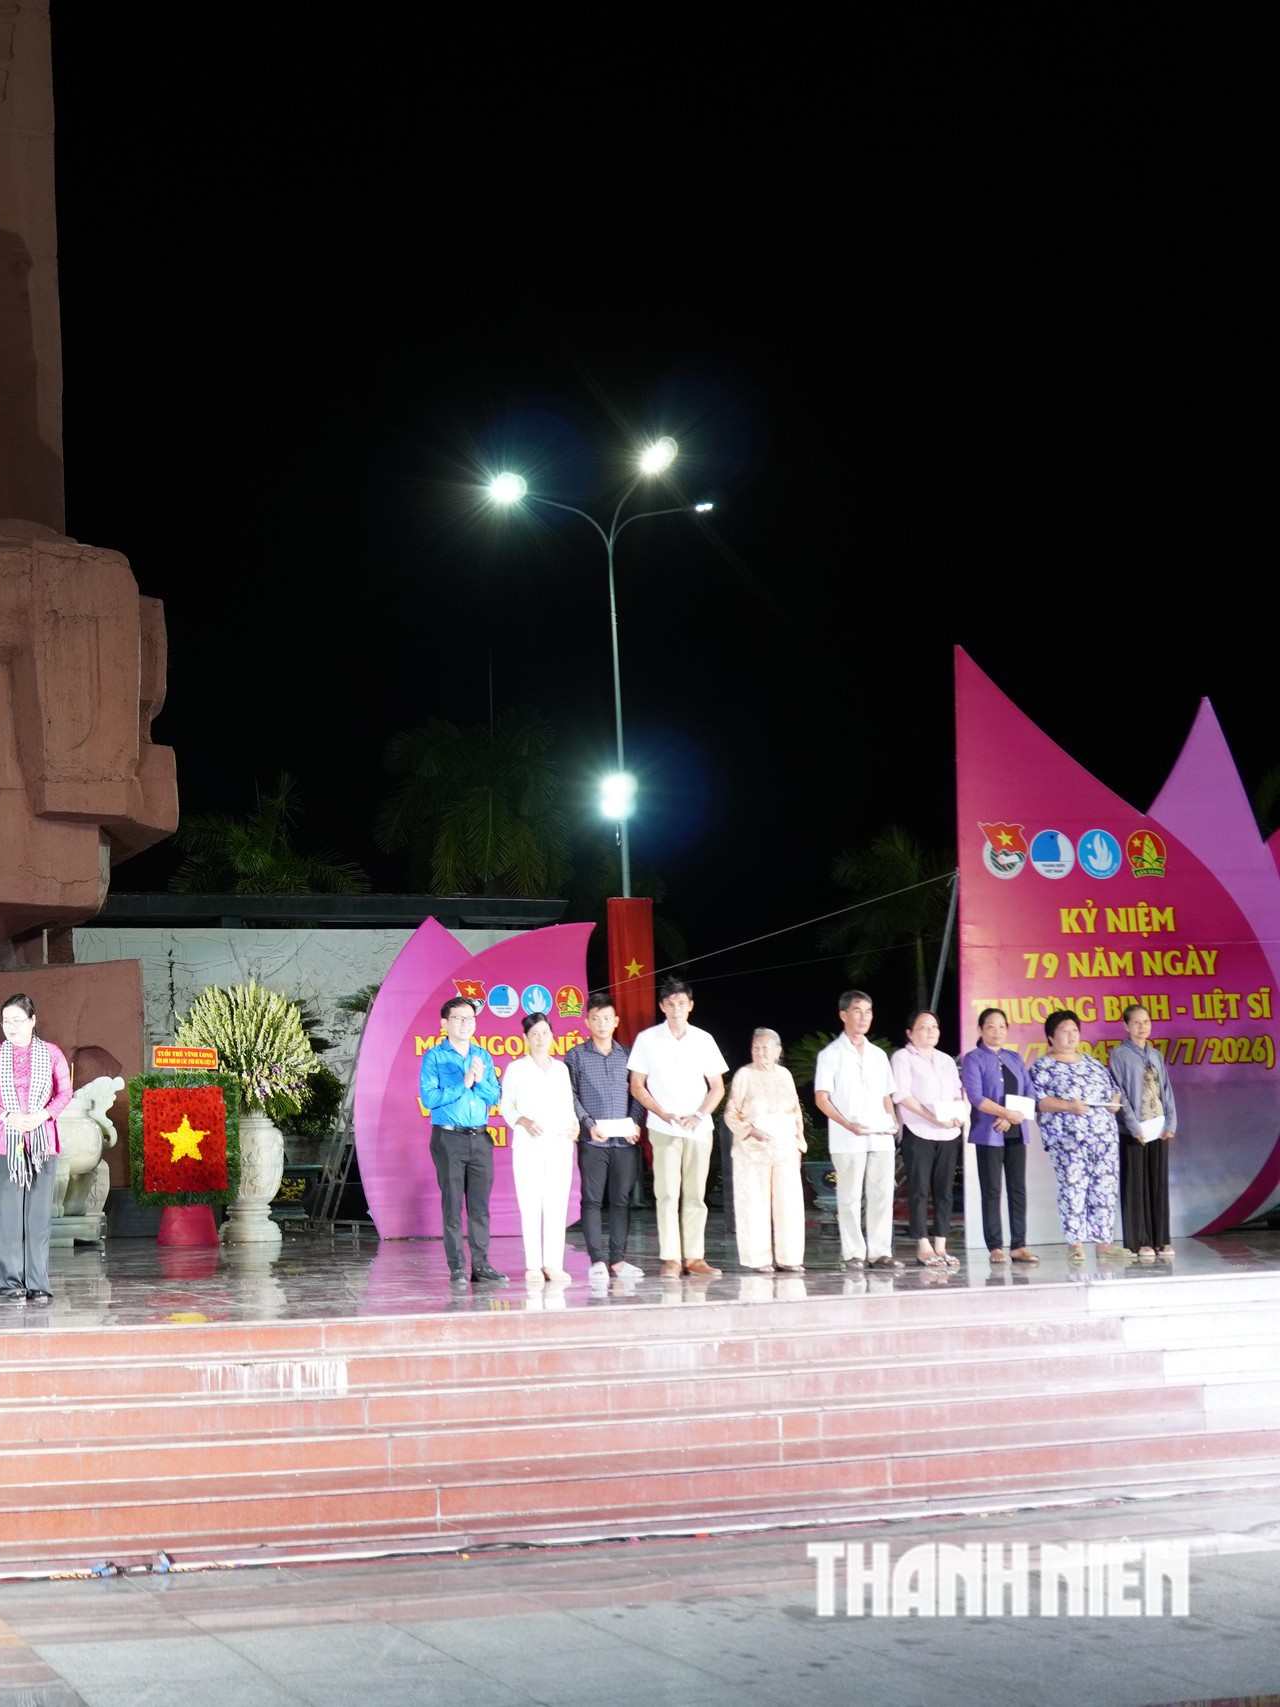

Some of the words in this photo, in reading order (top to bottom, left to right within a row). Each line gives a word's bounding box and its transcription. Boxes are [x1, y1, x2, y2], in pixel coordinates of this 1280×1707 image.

[1059, 899, 1098, 934] KỶ
[1104, 901, 1175, 938] NIỆM
[1023, 952, 1059, 979] 79
[1067, 947, 1135, 978] NĂM
[1140, 945, 1218, 977] NGÀY
[1192, 989, 1241, 1025] LIỆT
[1249, 987, 1272, 1019] SĨ
